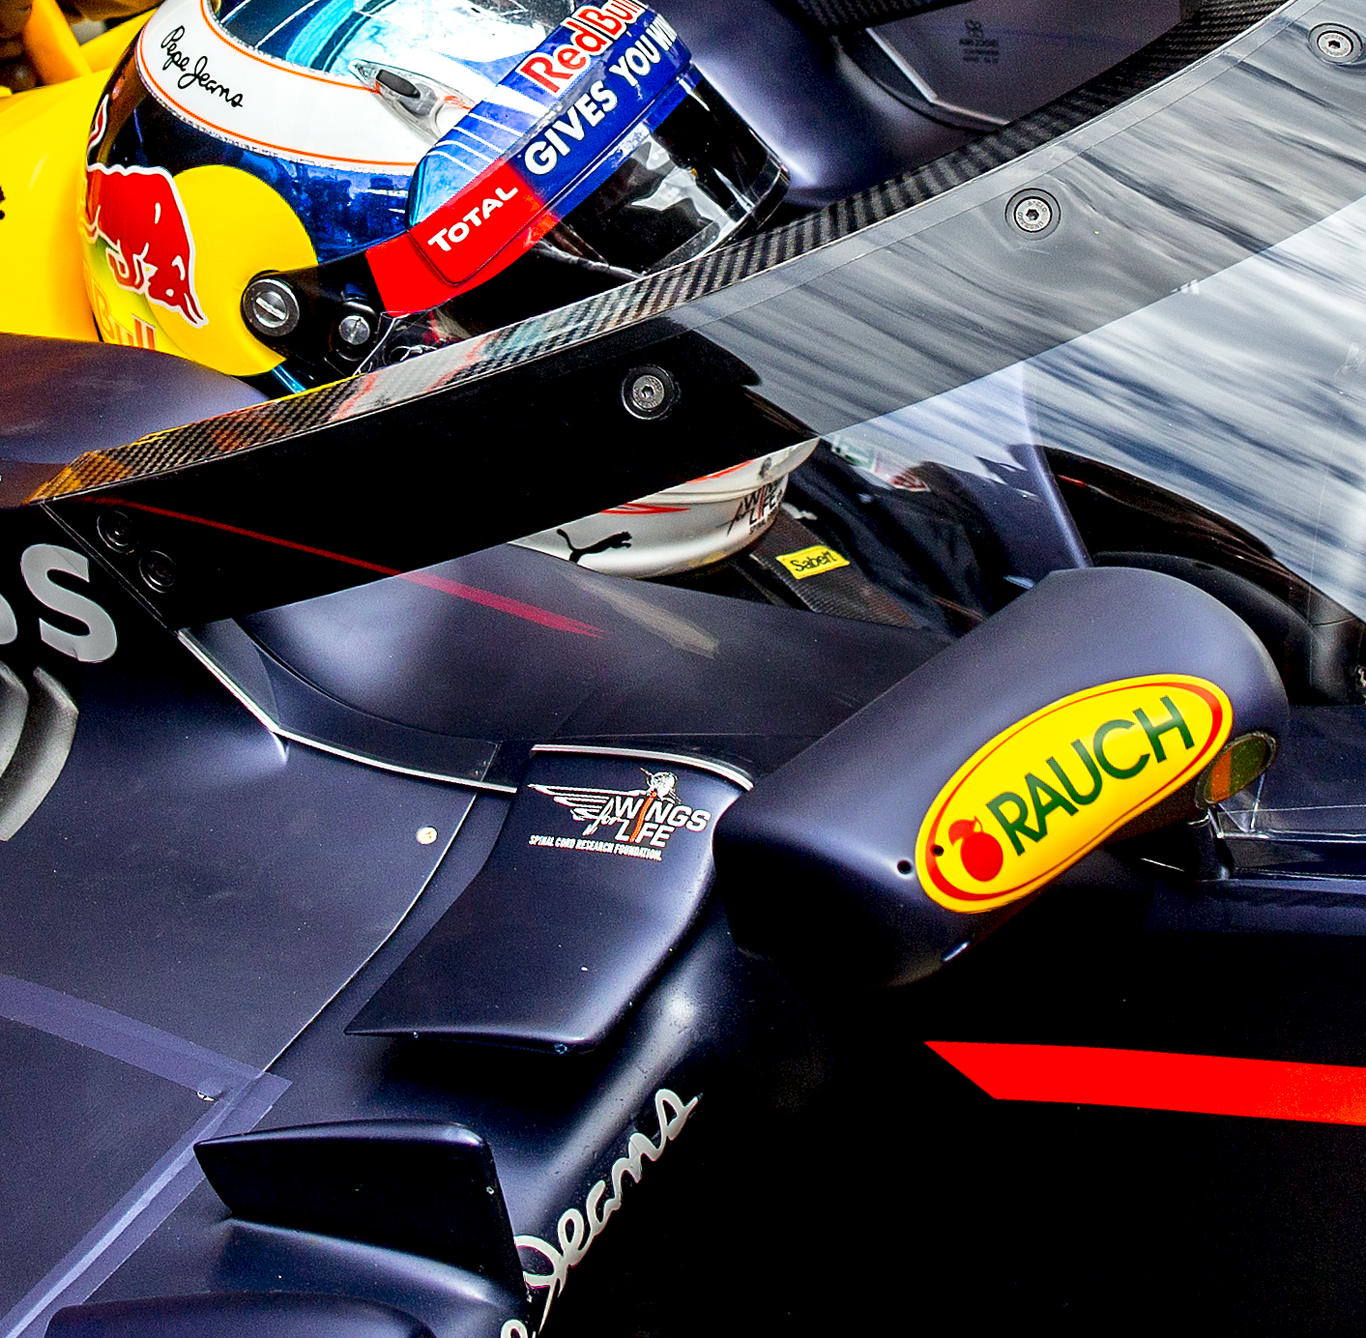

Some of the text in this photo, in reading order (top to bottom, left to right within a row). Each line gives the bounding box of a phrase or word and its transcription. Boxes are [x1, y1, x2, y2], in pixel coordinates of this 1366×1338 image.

[160, 24, 244, 109] Pepe Jeans
[523, 78, 619, 176] GIVES
[608, 34, 663, 88] YOU
[427, 186, 519, 252] TOTAL
[614, 792, 712, 833] WINGS
[985, 695, 1195, 857] RAUCH
[614, 819, 677, 849] LIFE
